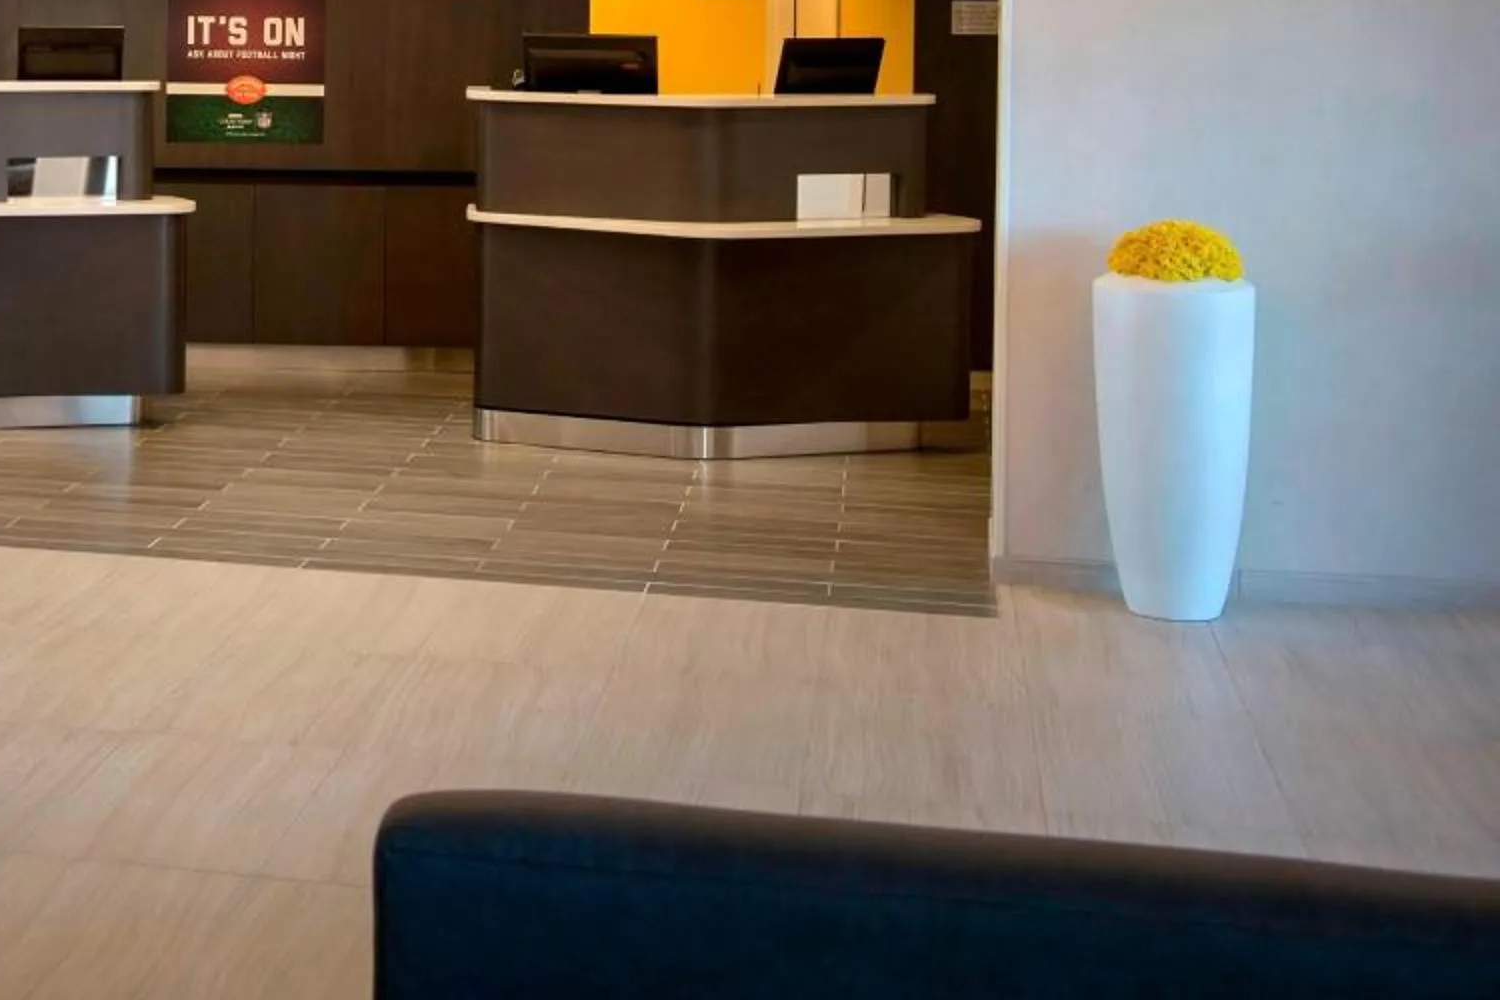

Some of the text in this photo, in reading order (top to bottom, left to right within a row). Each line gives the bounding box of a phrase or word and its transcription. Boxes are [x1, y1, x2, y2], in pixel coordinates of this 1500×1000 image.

[187, 15, 305, 47] IT'S ON
[187, 49, 305, 61] ASK ABOUT FOOTBALL NIGHT
